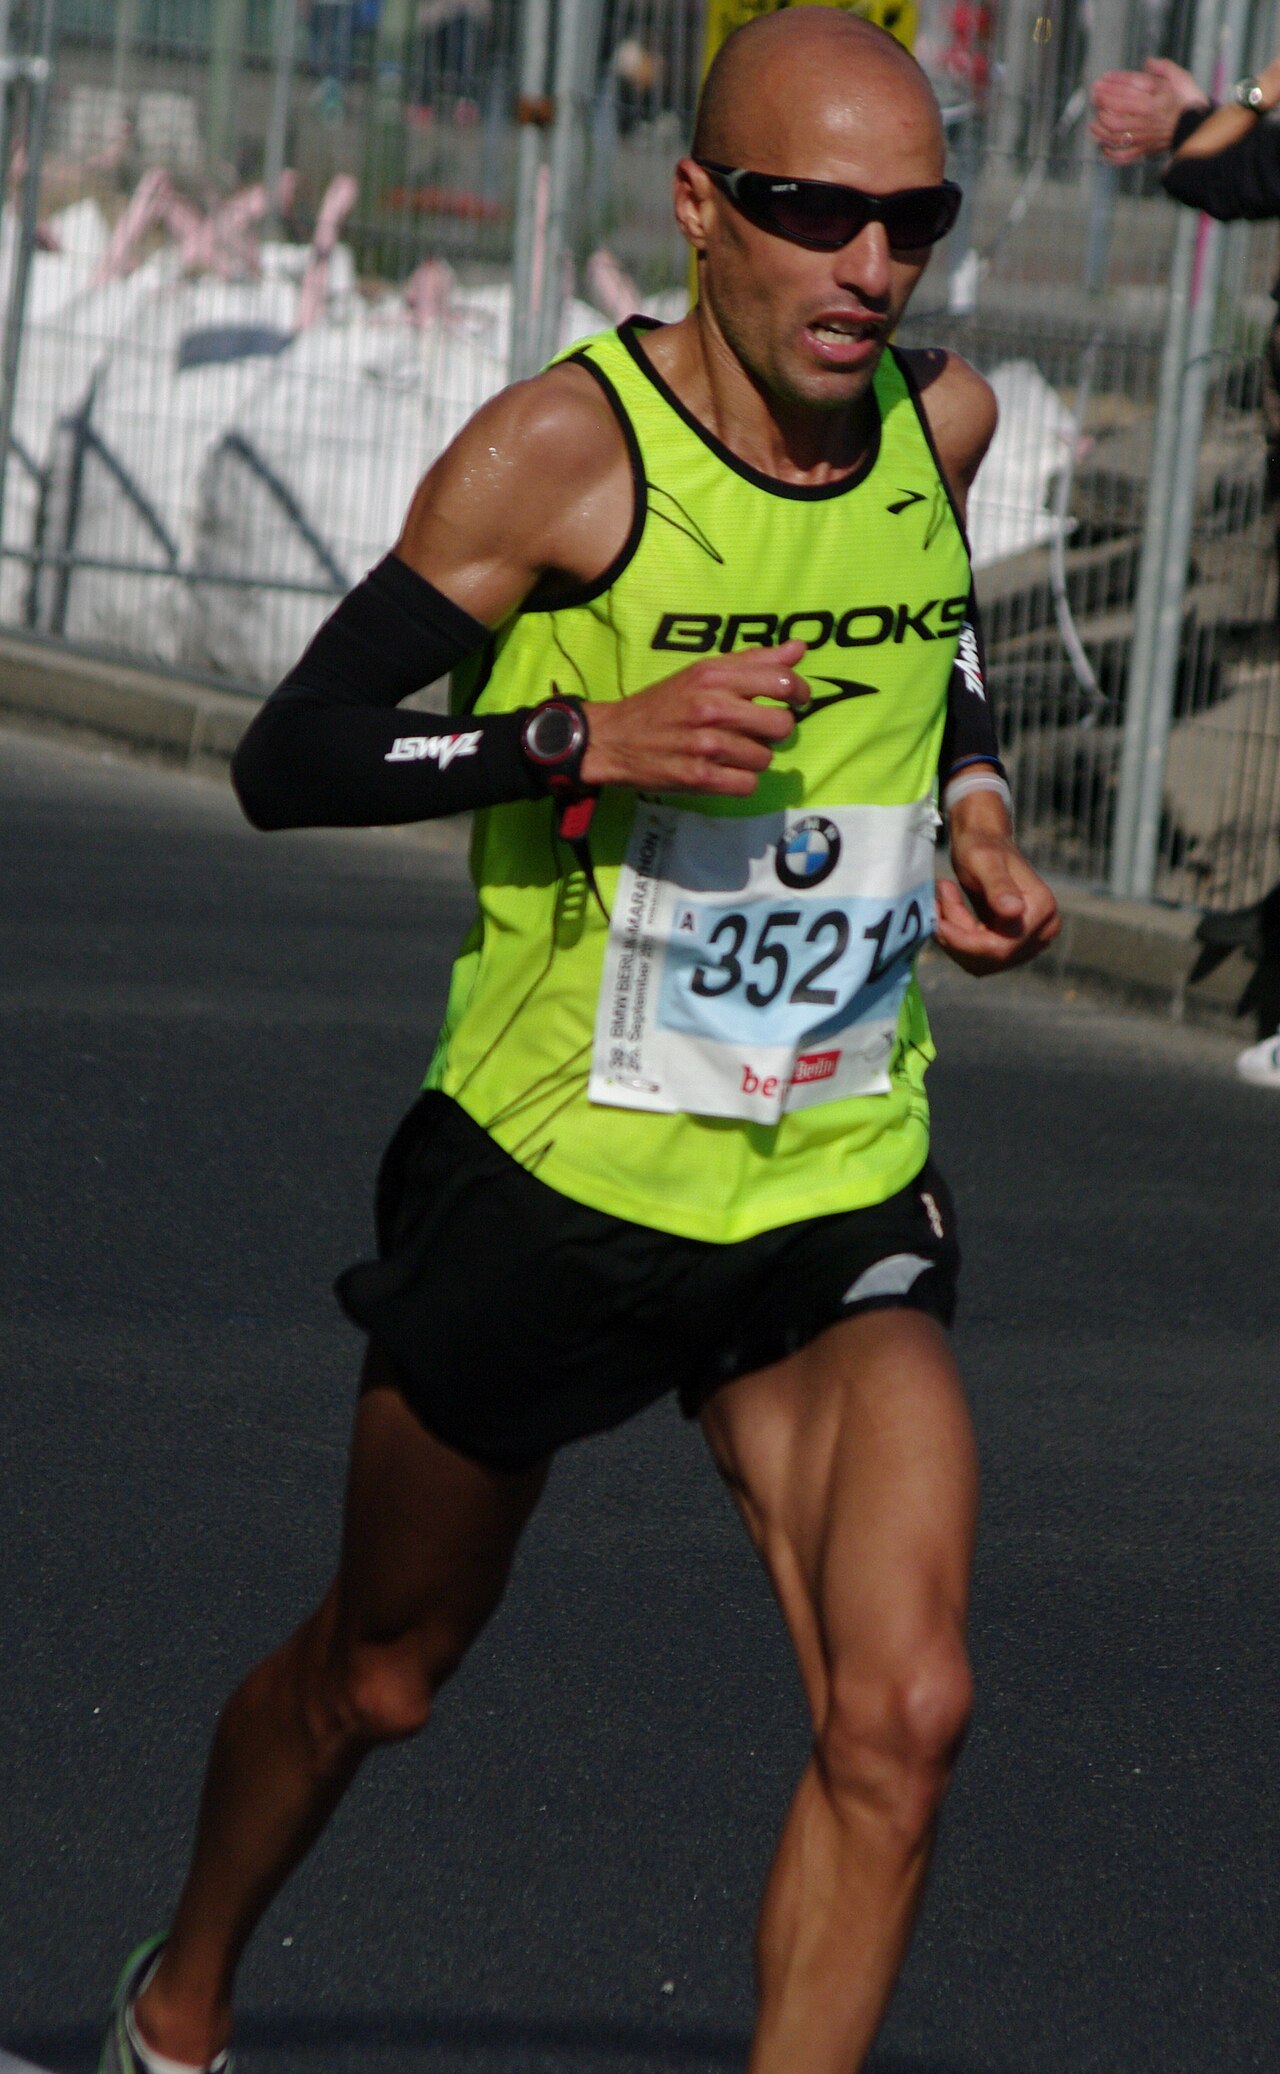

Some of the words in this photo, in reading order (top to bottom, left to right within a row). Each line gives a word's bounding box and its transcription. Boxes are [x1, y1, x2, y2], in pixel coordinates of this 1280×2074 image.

[651, 596, 967, 653] BROOKS
[384, 730, 484, 772] ZAMST
[680, 912, 695, 932] A
[610, 995, 628, 1038] BMW
[628, 962, 650, 1042] September
